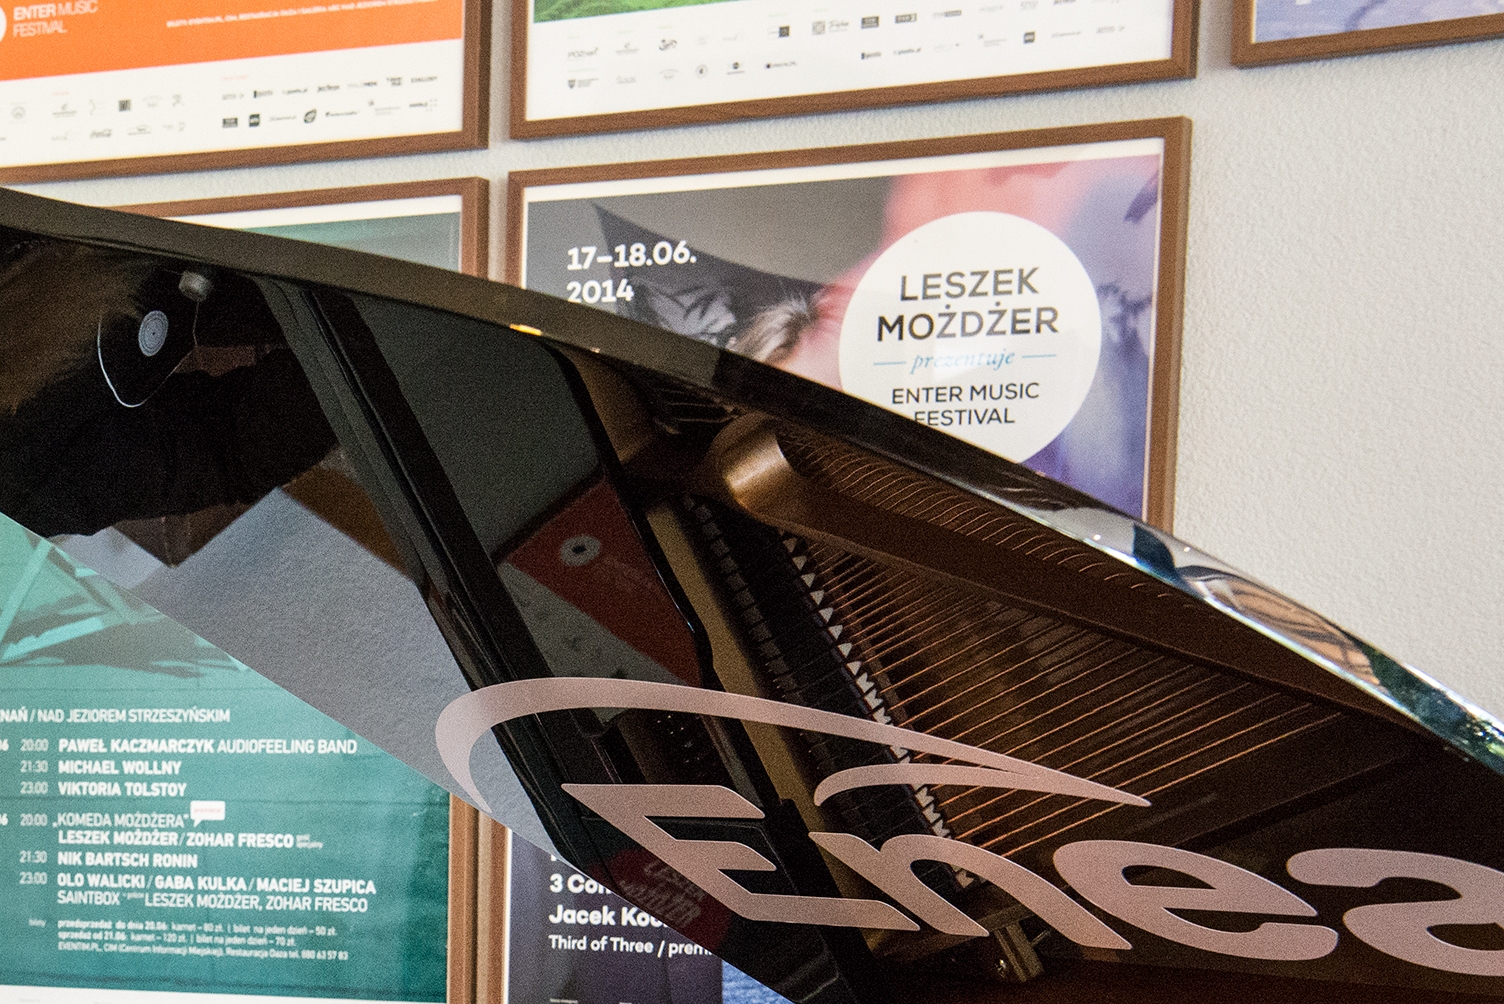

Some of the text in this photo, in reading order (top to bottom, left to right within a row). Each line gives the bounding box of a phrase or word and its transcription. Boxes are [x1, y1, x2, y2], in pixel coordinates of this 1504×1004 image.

[13, 0, 98, 21] ENTER MUSIC
[13, 20, 67, 37] FESTIVAL
[566, 278, 634, 303] 2014
[900, 267, 1039, 301] LESZEK
[877, 301, 1059, 342] MOŻDŻER
[910, 349, 1015, 374] prezentuje
[892, 382, 1040, 404] ENTER MUSIC
[914, 407, 1015, 426] FESTIVAL
[37, 709, 64, 723] NAD
[66, 709, 126, 723] JEZIOREM
[128, 706, 231, 723] STRZESZYŃSKIM
[58, 738, 107, 753] PAWEŁ
[110, 738, 214, 753] KACZMARCZYK
[217, 739, 314, 754] AUDIOFEELING
[317, 739, 358, 754] BAND
[58, 760, 119, 775] MICHAEL
[122, 760, 182, 775] WOLLNY
[58, 782, 121, 796] VIKTORIA
[125, 782, 187, 797] TOLSTOY
[58, 830, 110, 845] LESZEK
[113, 828, 178, 846] MOŻDŻER
[186, 832, 234, 847] ZOHAR
[238, 833, 294, 848] FRESCO
[58, 852, 82, 866] NIK
[85, 852, 149, 867] BARTSCH
[153, 853, 198, 868] RONIN
[57, 873, 84, 887] OLO
[87, 873, 145, 888] WALICKI
[154, 875, 194, 890] GABA
[198, 876, 247, 891] KULKA
[257, 877, 310, 893] MACIEJ
[313, 878, 376, 894] SZUPICA
[550, 873, 563, 893] 3
[562, 783, 1504, 976] Enea
[57, 890, 120, 905] SAINTBOX
[145, 893, 194, 908] LESZEK
[266, 895, 311, 910] ZOHAR
[314, 897, 368, 912] FRESCO
[548, 904, 615, 925] Jacek
[548, 934, 587, 950] Third
[590, 935, 608, 951] of
[610, 937, 654, 953] Three
[657, 940, 666, 958] /
